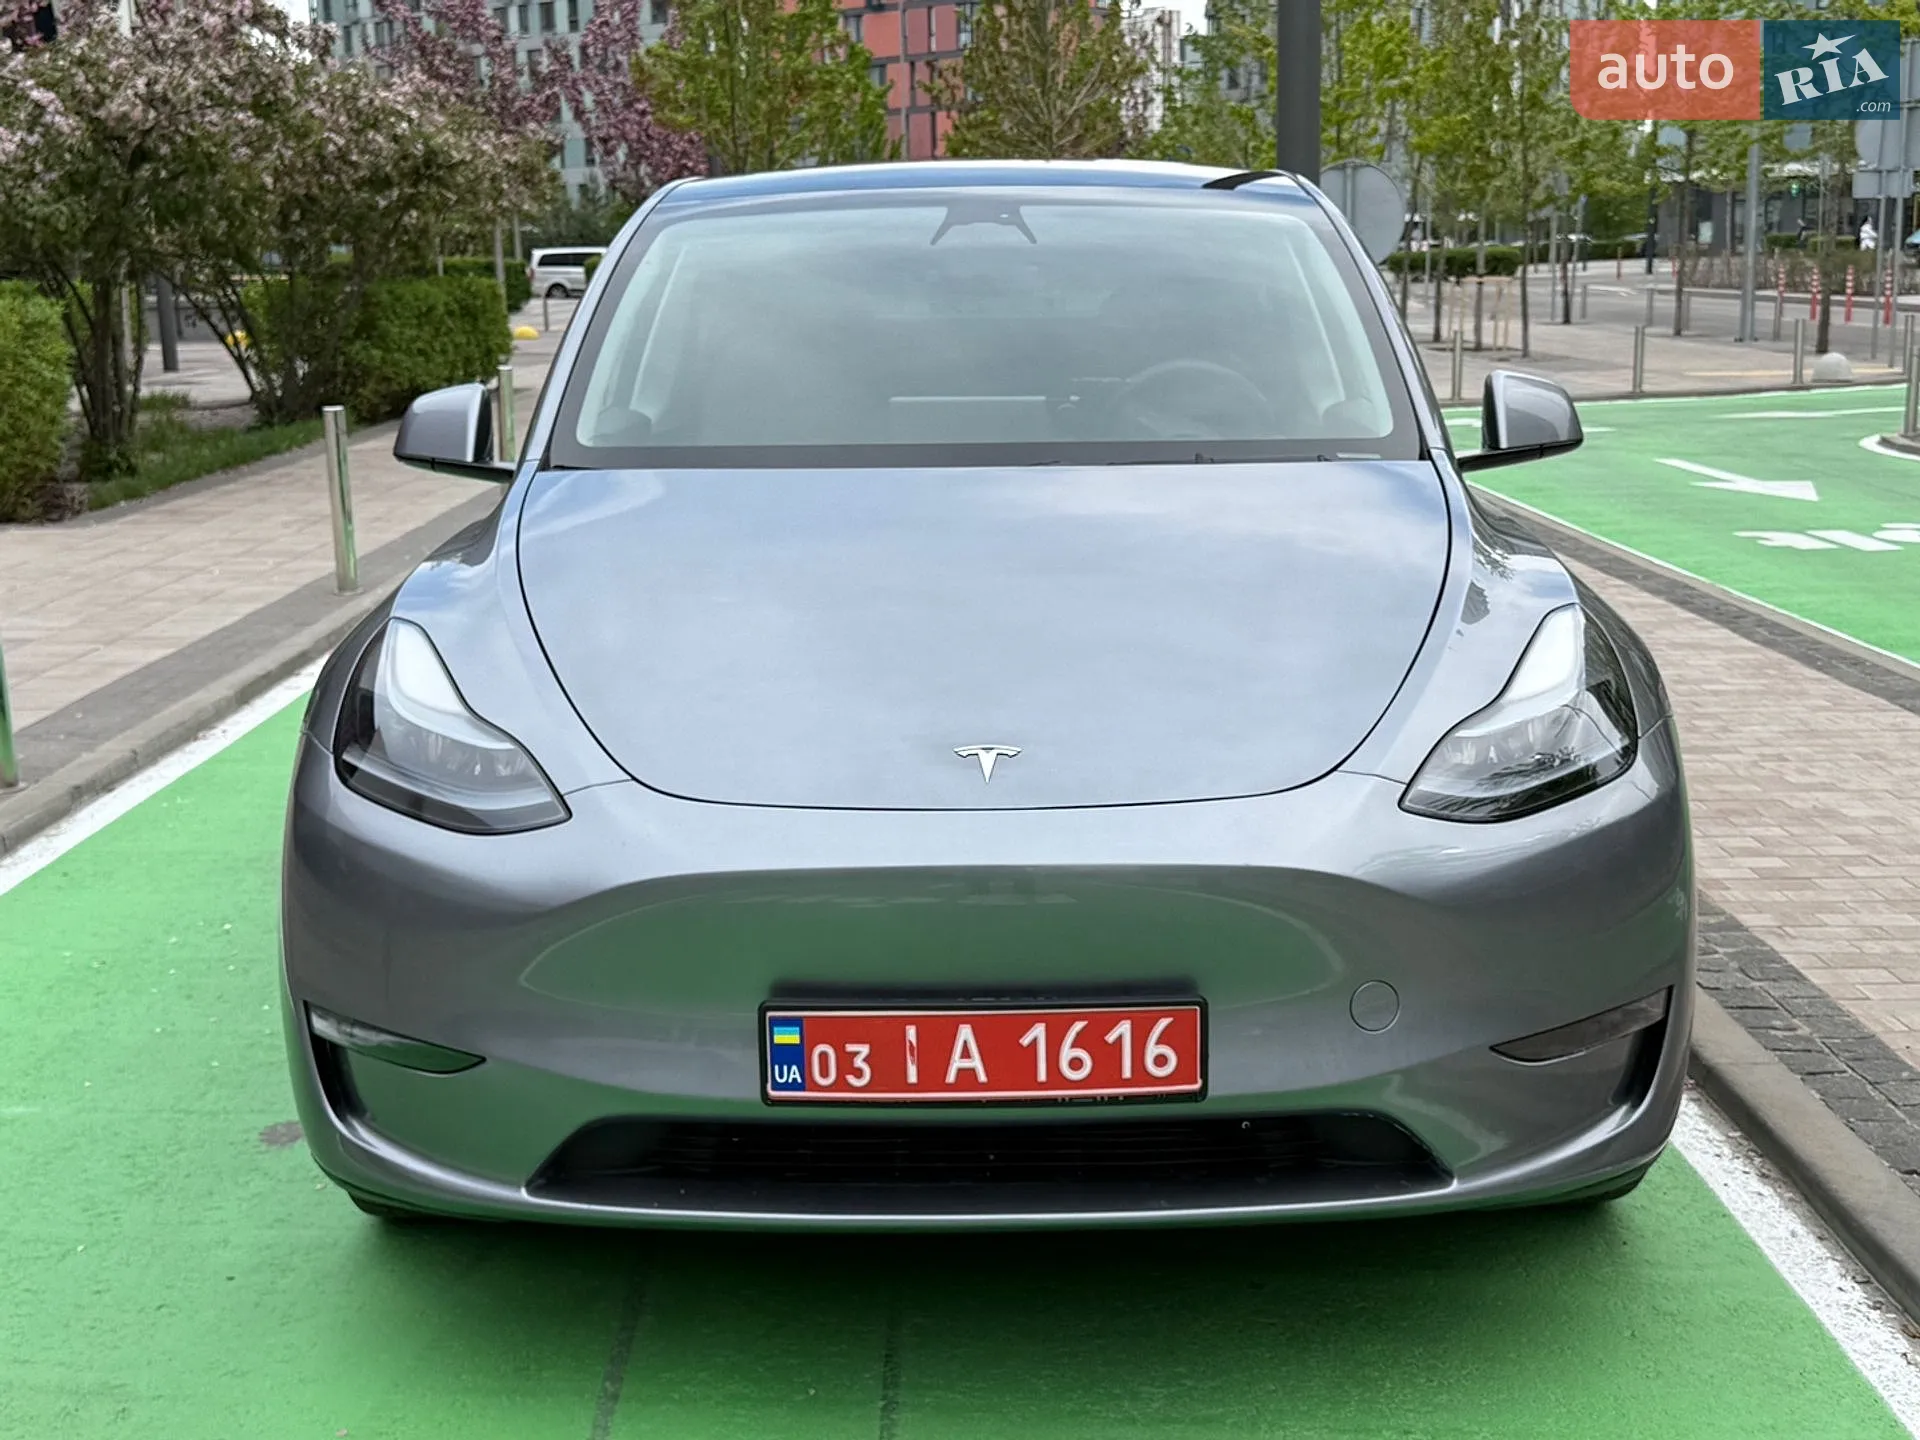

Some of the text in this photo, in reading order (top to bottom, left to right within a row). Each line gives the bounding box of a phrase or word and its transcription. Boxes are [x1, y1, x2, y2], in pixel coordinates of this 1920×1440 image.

[774, 1065, 802, 1084] UA
[811, 1043, 872, 1088] 03
[1018, 1017, 1179, 1084] 1616
